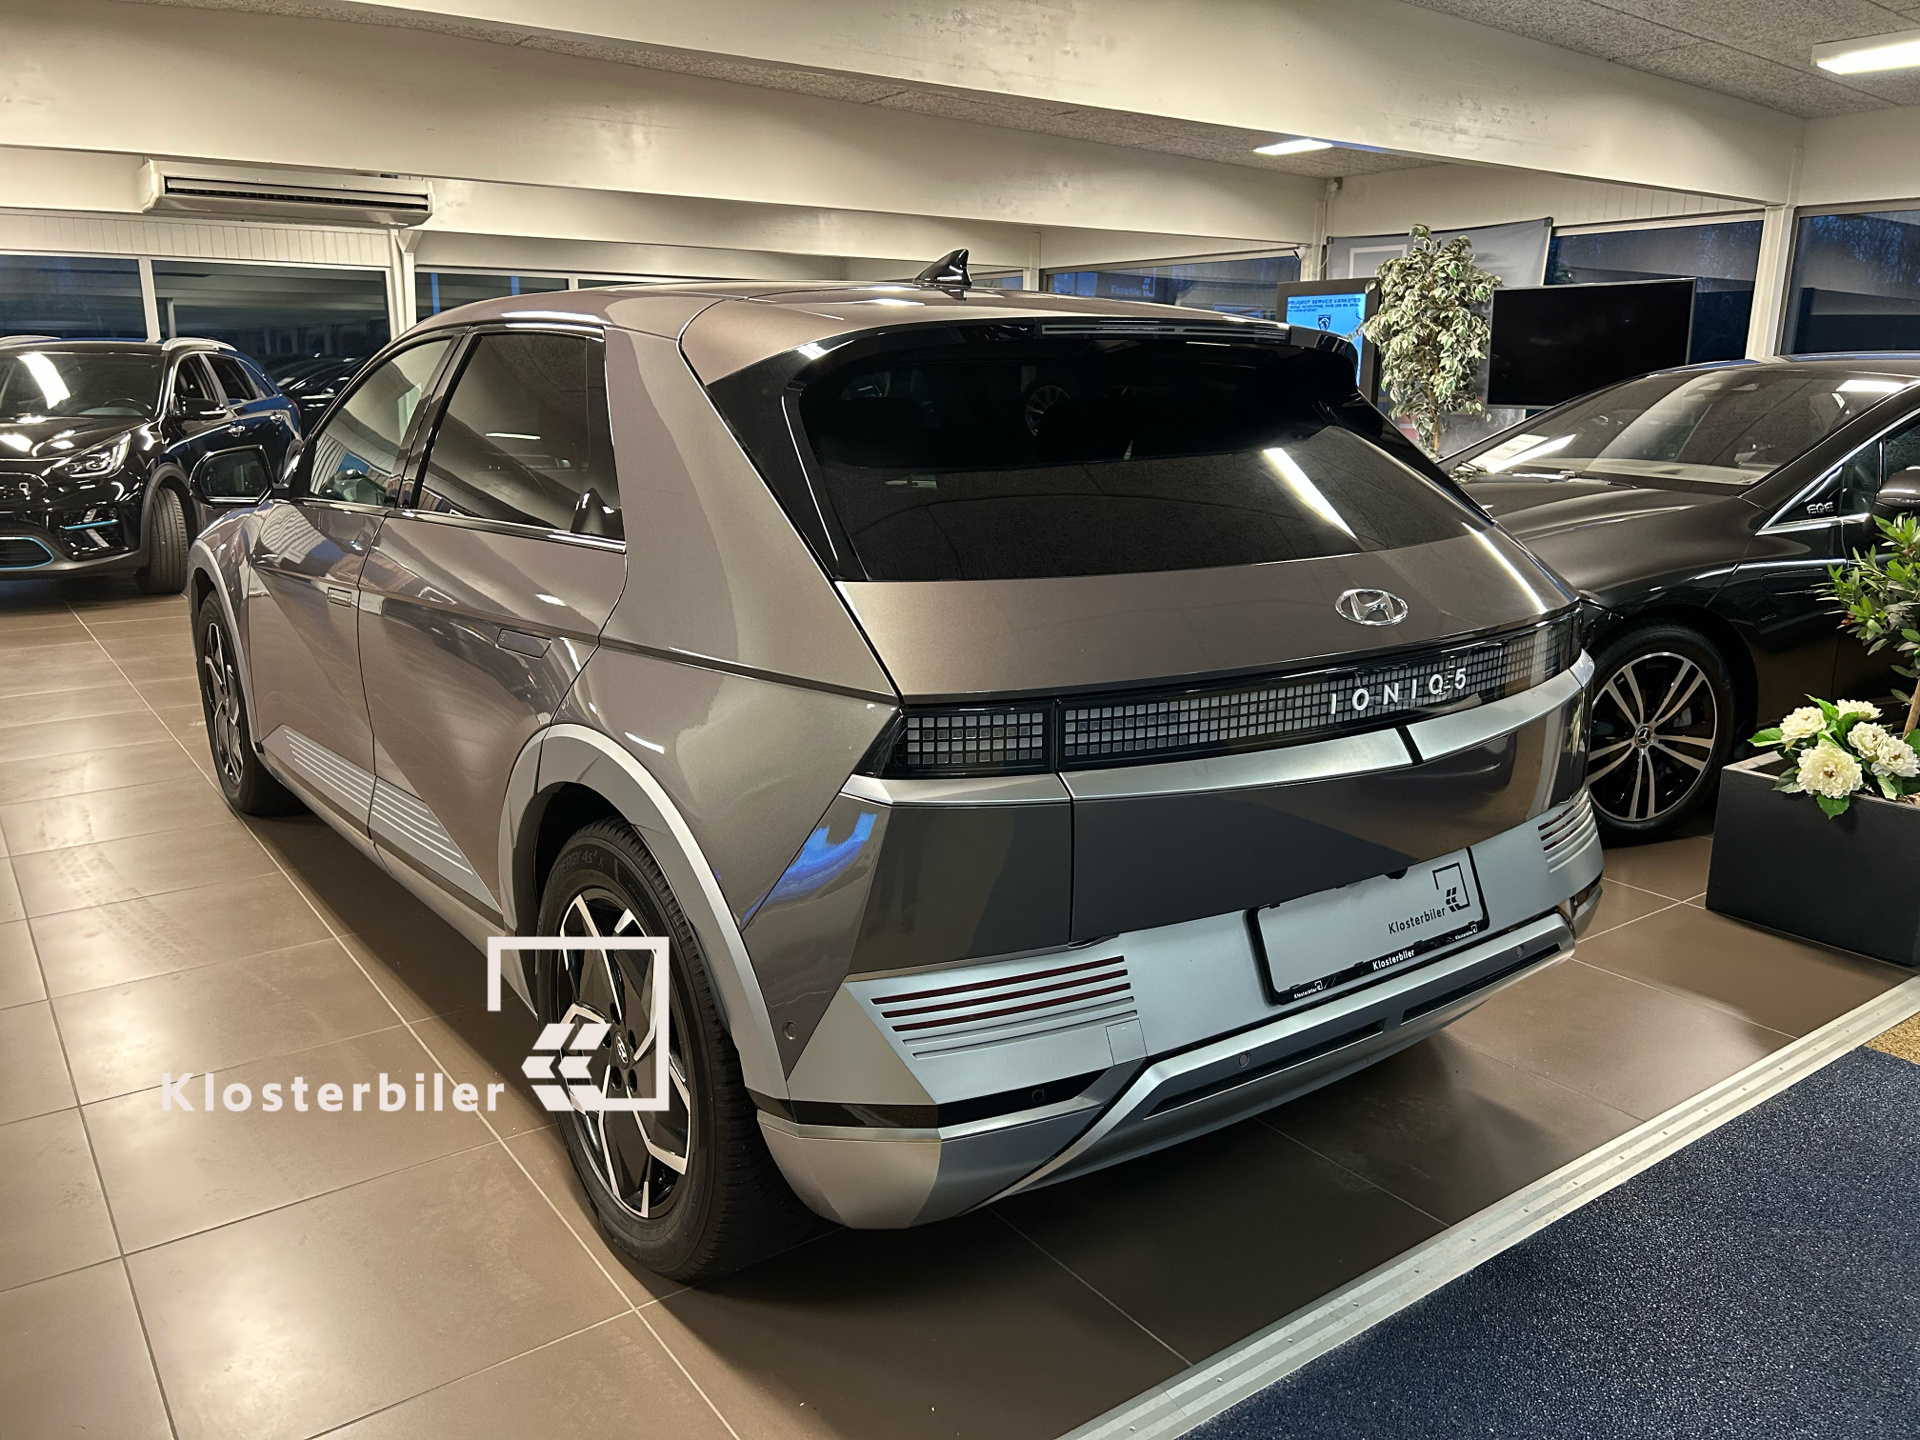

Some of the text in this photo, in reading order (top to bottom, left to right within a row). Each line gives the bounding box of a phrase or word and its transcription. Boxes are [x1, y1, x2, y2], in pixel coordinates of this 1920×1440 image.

[1806, 501, 1835, 514] EQE
[1330, 668, 1467, 715] IONIQ 5
[1388, 906, 1446, 935] Klosterbiler
[1372, 949, 1415, 971] Klosterbiler
